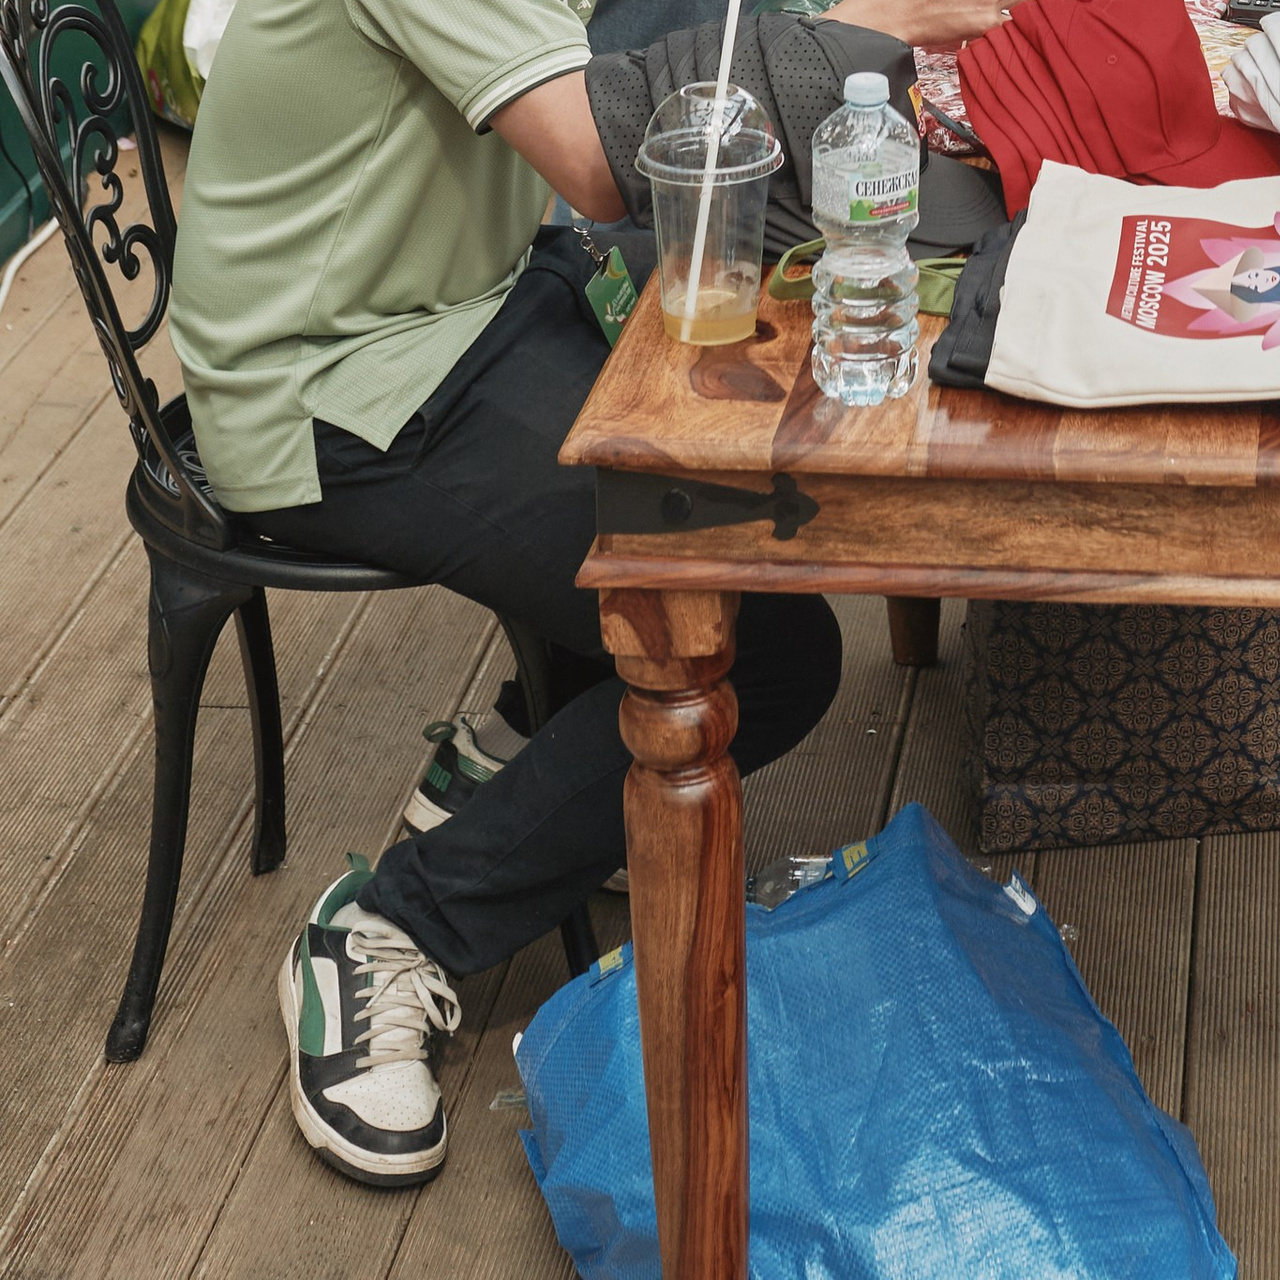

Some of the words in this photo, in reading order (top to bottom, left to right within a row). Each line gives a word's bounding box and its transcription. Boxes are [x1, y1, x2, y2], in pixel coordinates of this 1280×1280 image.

[1132, 219, 1148, 266] FESTIVAL
[1146, 220, 1172, 267] 2025
[1136, 269, 1166, 330] MOSCOW
